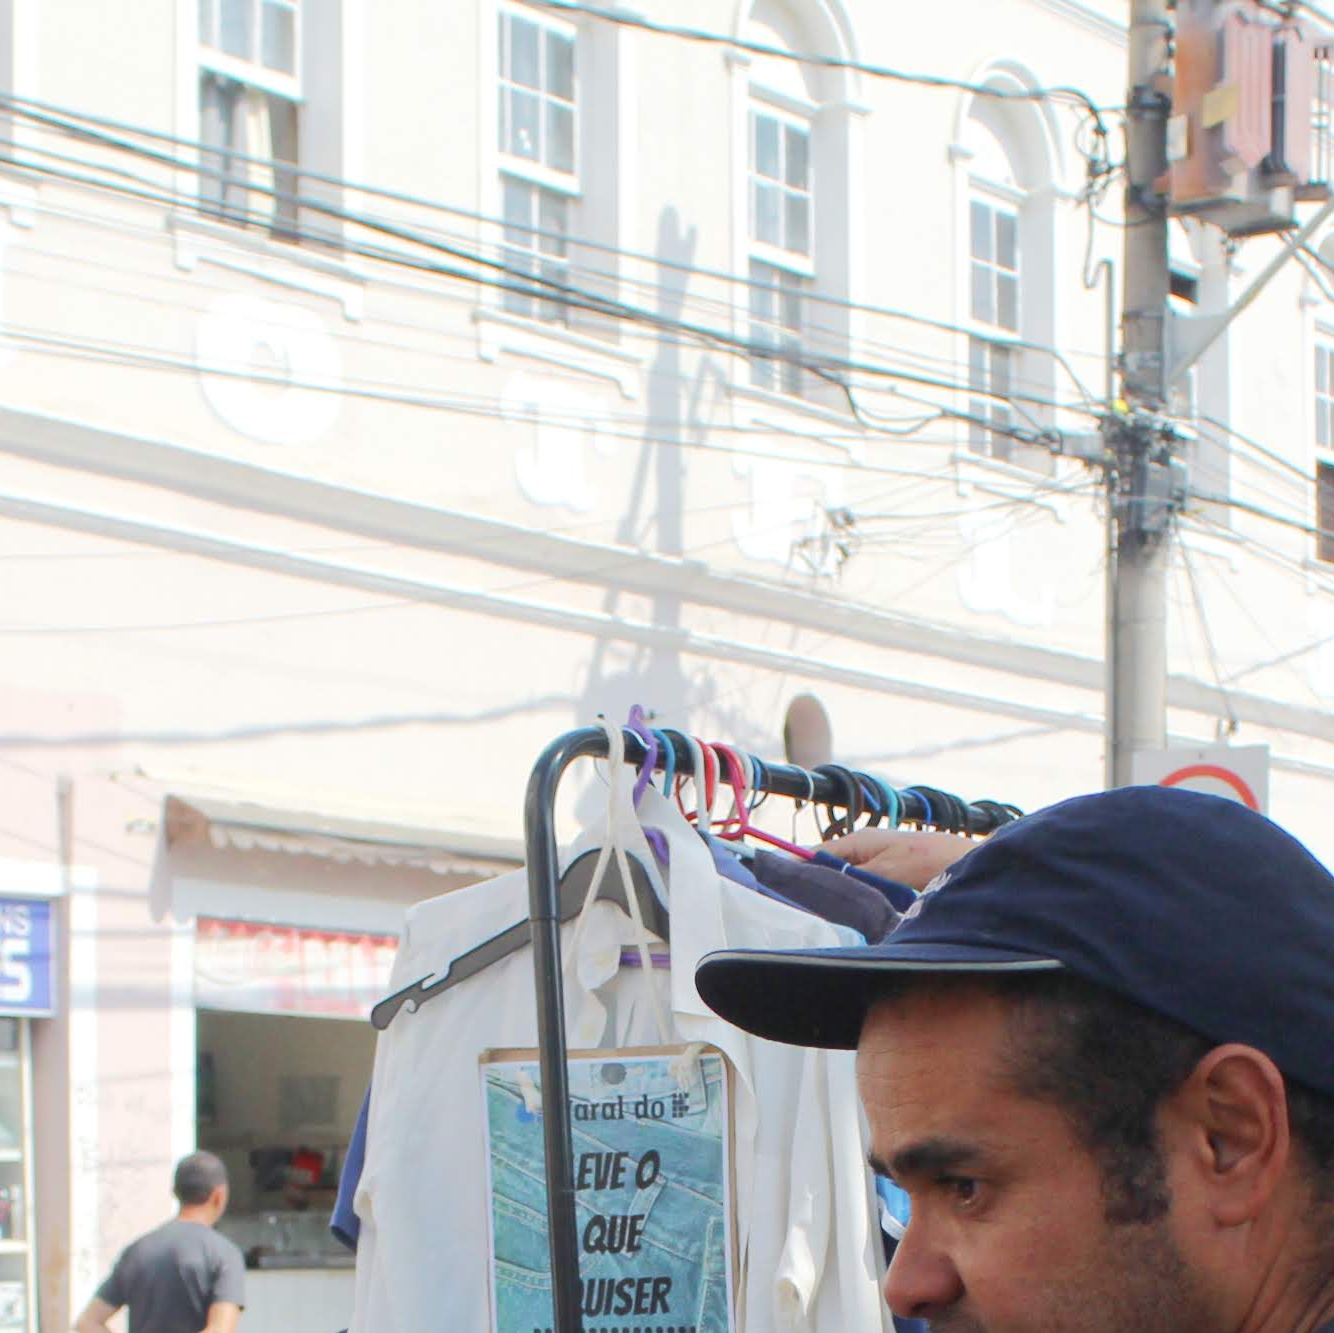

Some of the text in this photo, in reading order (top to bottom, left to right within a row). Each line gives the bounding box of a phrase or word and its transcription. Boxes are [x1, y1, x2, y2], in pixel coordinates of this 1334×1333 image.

[568, 1093, 665, 1122] aral do
[574, 1149, 661, 1192] EVE O
[582, 1213, 645, 1256] QUE
